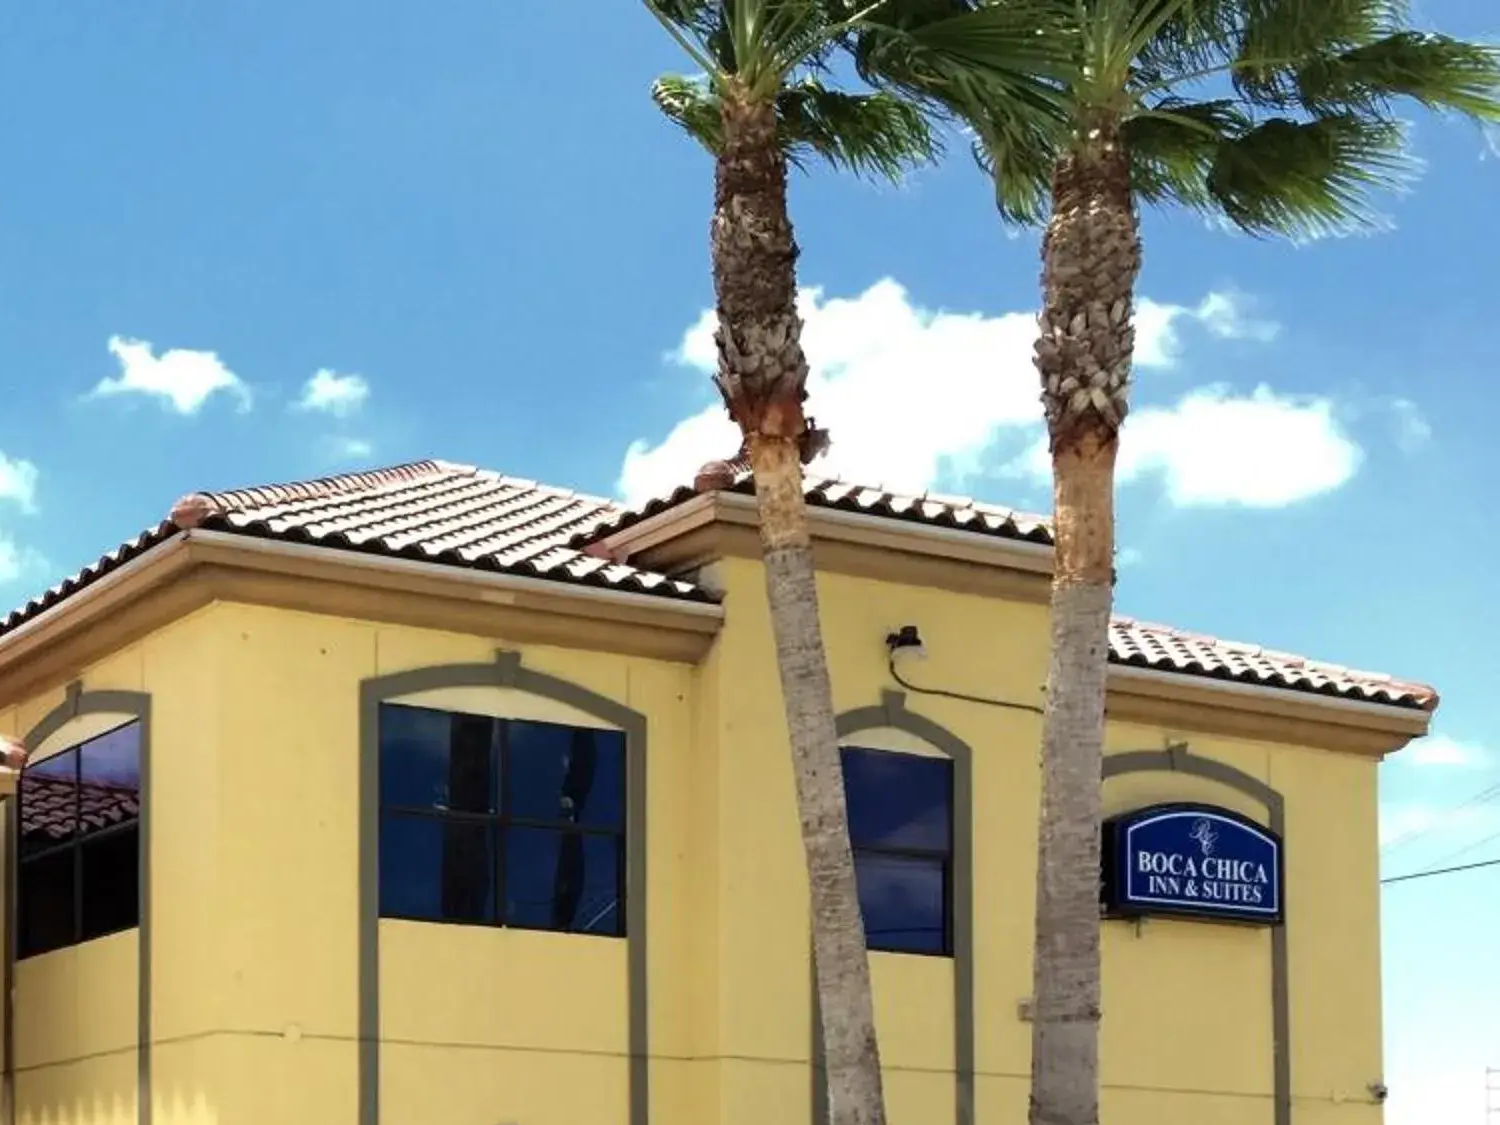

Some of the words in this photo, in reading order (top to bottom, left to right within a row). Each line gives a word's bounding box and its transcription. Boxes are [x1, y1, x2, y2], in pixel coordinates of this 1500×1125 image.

[1138, 850, 1198, 877] BOCA
[1202, 857, 1268, 884] CHICA
[1149, 876, 1181, 895] INN
[1185, 879, 1199, 897] &
[1203, 881, 1262, 904] SUITES
